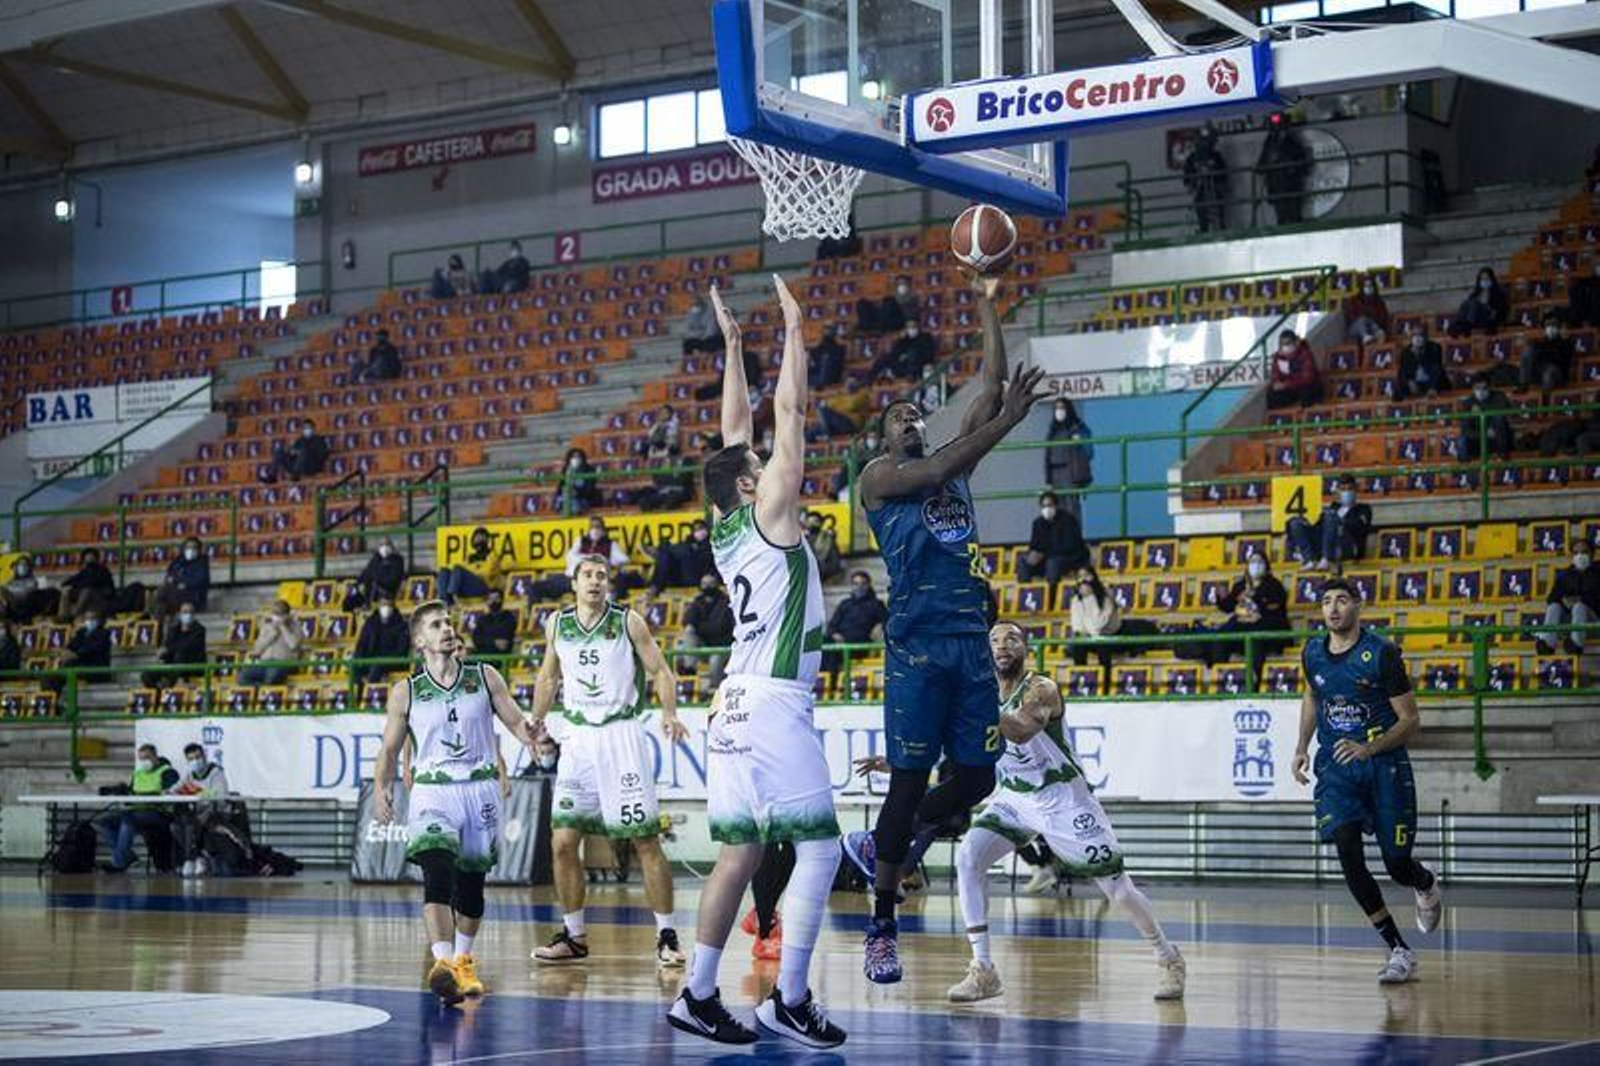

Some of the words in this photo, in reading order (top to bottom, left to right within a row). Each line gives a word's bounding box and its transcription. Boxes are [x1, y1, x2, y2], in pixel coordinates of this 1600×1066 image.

[976, 73, 1186, 122] BricoCentro
[404, 135, 484, 166] CAFETERIA
[595, 165, 681, 198] GRADA
[560, 236, 575, 261] 2
[117, 289, 129, 314] 1
[1049, 374, 1105, 396] SAIDA
[29, 392, 94, 424] BAR
[1284, 484, 1308, 516] 4
[446, 530, 516, 565] PITA
[529, 522, 695, 561] BOUVARD
[732, 574, 758, 625] 2
[578, 648, 600, 667] 55
[447, 706, 459, 723] 4
[620, 802, 646, 827] 55
[1084, 844, 1113, 865] 23
